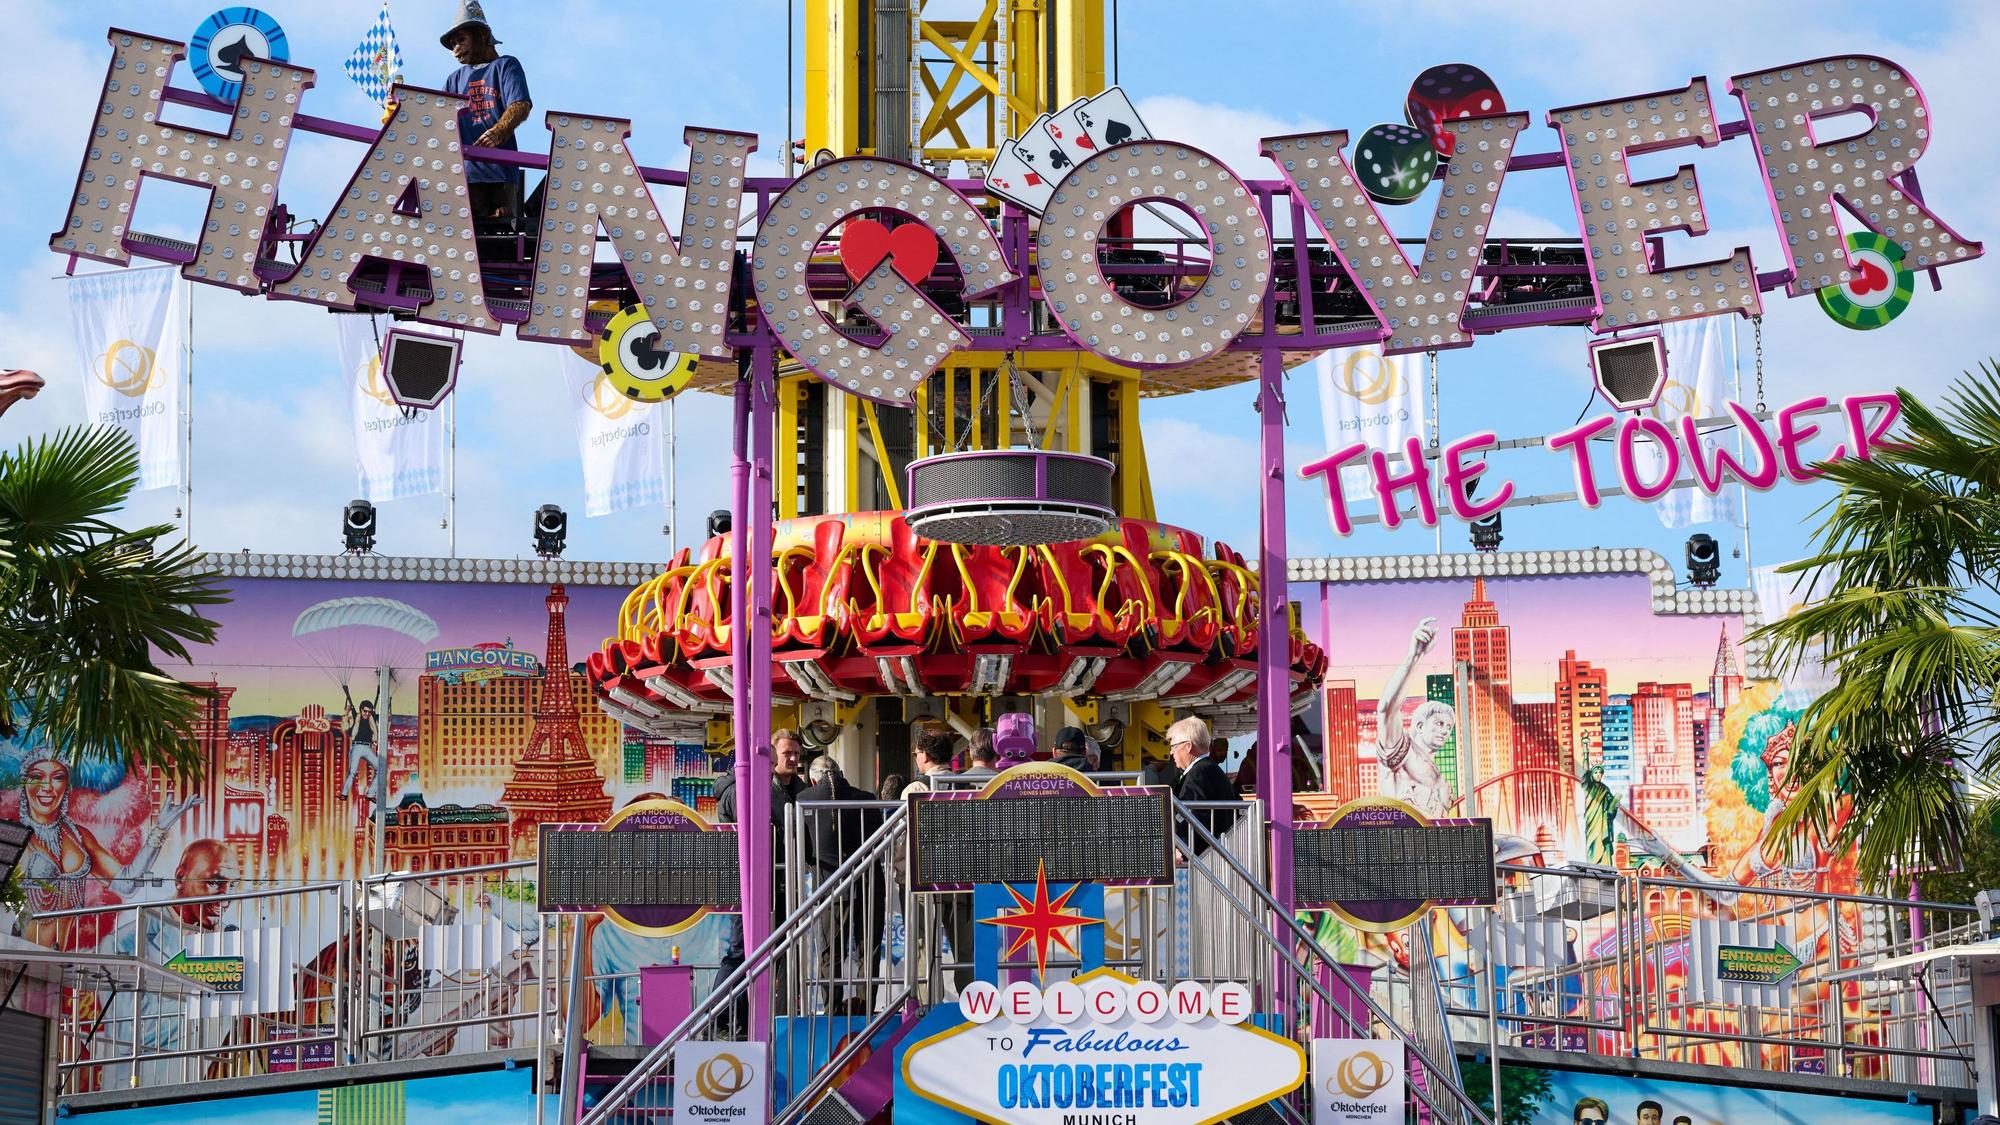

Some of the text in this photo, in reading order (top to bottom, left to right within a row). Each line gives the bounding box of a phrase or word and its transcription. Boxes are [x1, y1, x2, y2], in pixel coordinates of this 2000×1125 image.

[50, 27, 1983, 407] HANGOVER
[1301, 392, 1916, 537] THE TOWER
[427, 649, 536, 669] HANGOVER
[1005, 779, 1074, 791] HANGOVER
[229, 802, 261, 834] NO
[626, 815, 689, 825] HANGOVER
[1346, 811, 1407, 821] HANGOVER
[1720, 949, 1792, 965] ENTRANCE
[1728, 962, 1782, 974] EINGANG
[966, 991, 1240, 1017] WELCOME
[987, 1028, 1190, 1059] TO Fabulous
[998, 1062, 1202, 1110] OKTOBERFEST
[688, 1105, 746, 1117] Oktoberfest
[1330, 1101, 1387, 1114] Oktoberfest
[1063, 1114, 1136, 1125] MUNICH
